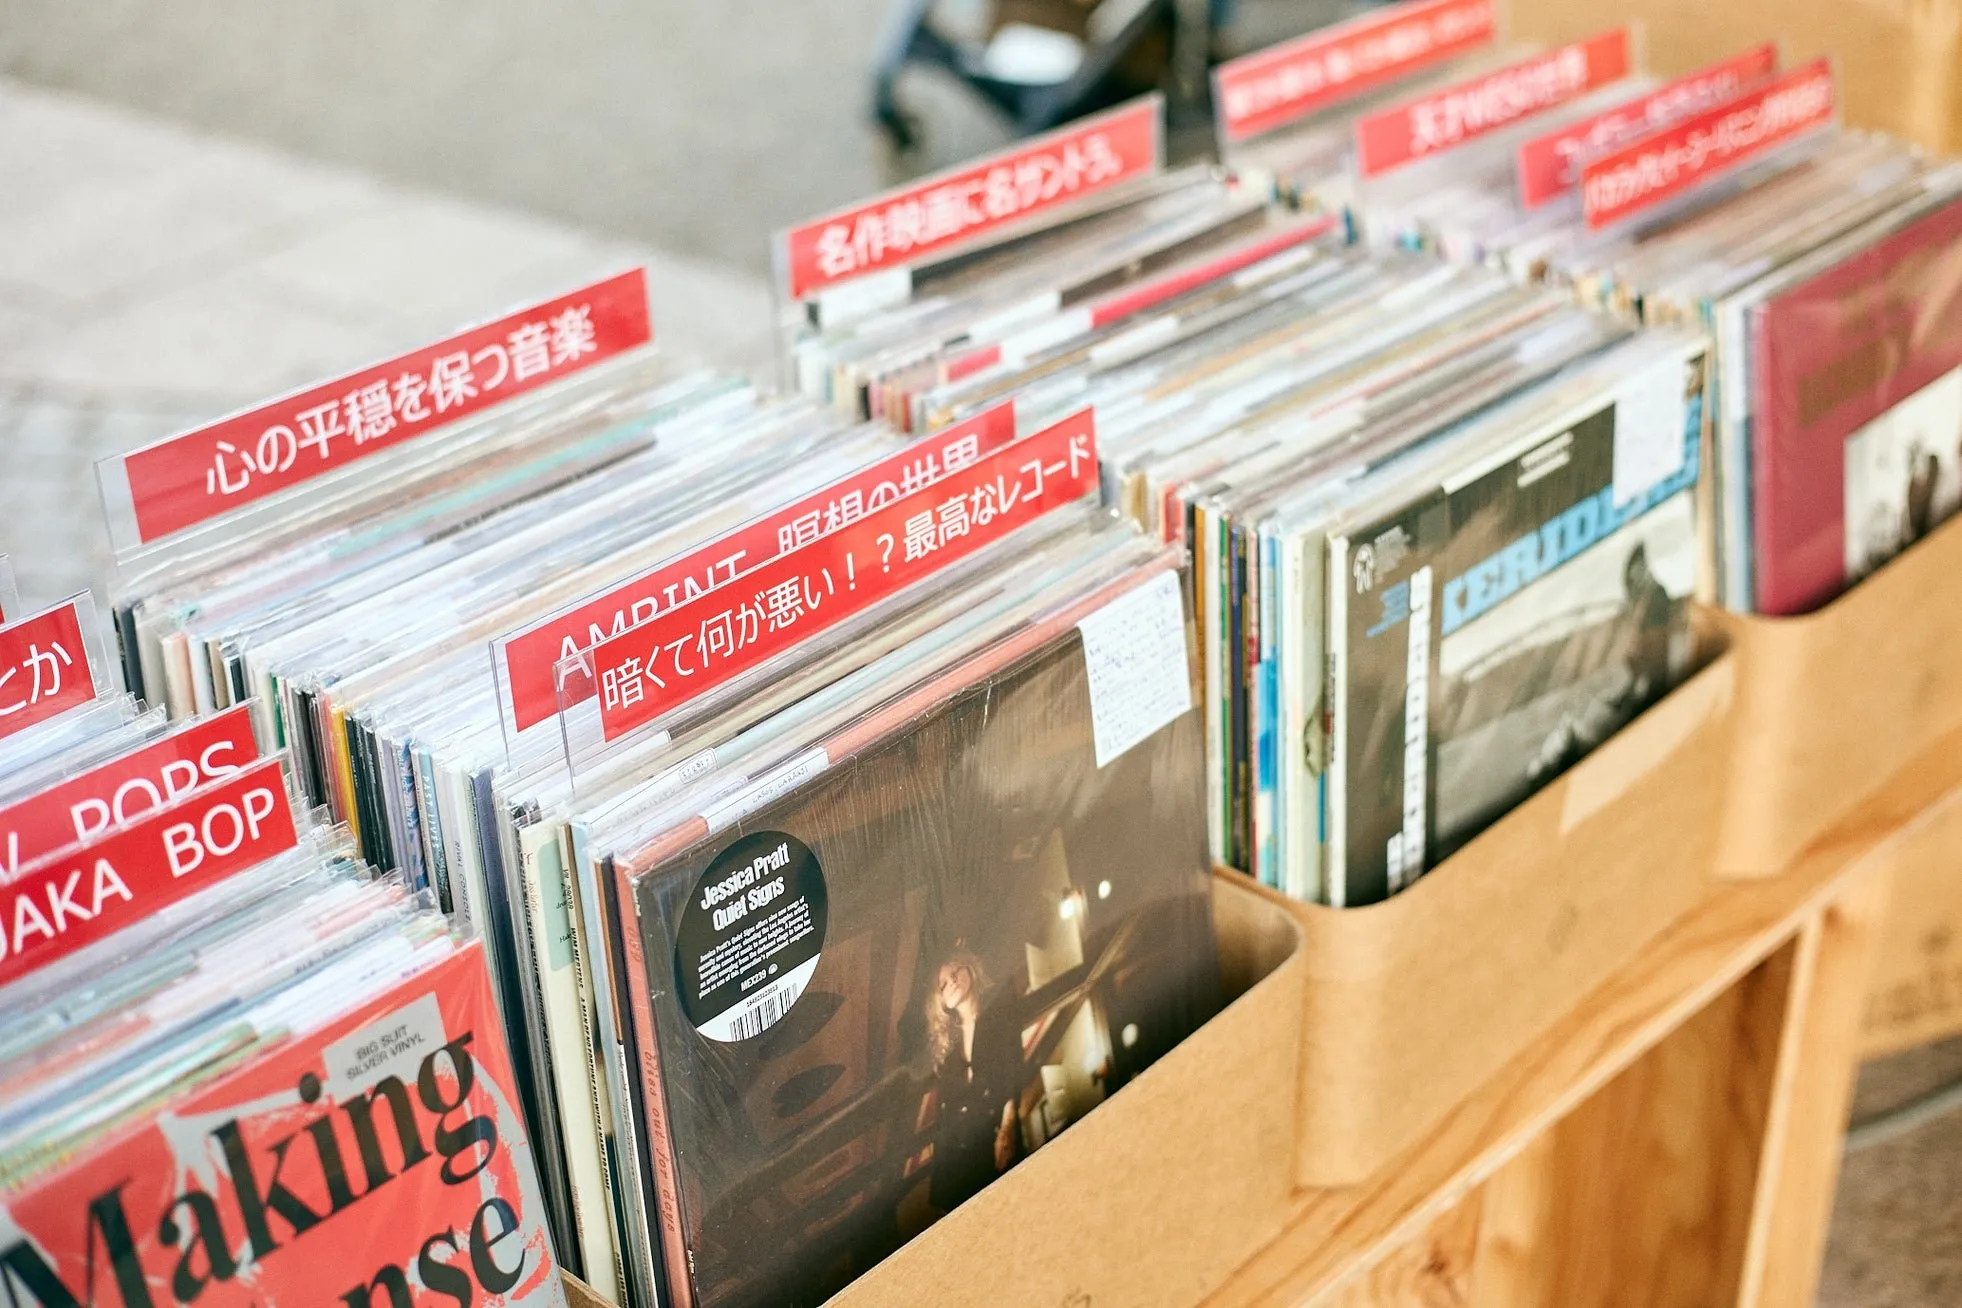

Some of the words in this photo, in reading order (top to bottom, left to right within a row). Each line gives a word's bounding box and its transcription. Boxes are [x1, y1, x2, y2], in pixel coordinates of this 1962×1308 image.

[206, 304, 596, 495] 心の平穏を保つ音楽
[0, 858, 134, 965] AKA
[161, 787, 275, 878] BOP
[701, 865, 754, 911] Jessica
[755, 842, 791, 881] Pratt
[713, 898, 748, 932] Quiet
[748, 876, 786, 912] Signs
[741, 969, 767, 992] MEX239
[581, 1002, 590, 1025] MAN
[346, 1050, 389, 1080] SILVER
[389, 1032, 426, 1056] VINYL
[357, 1041, 379, 1060] BIG
[381, 1024, 407, 1047] SUIT
[645, 1051, 658, 1097] bliss
[594, 1102, 603, 1125] WITH
[652, 1107, 666, 1140] out
[598, 1130, 607, 1156] NAME
[655, 1147, 669, 1179] for
[0, 1031, 498, 1308] Making
[661, 1189, 675, 1233] days
